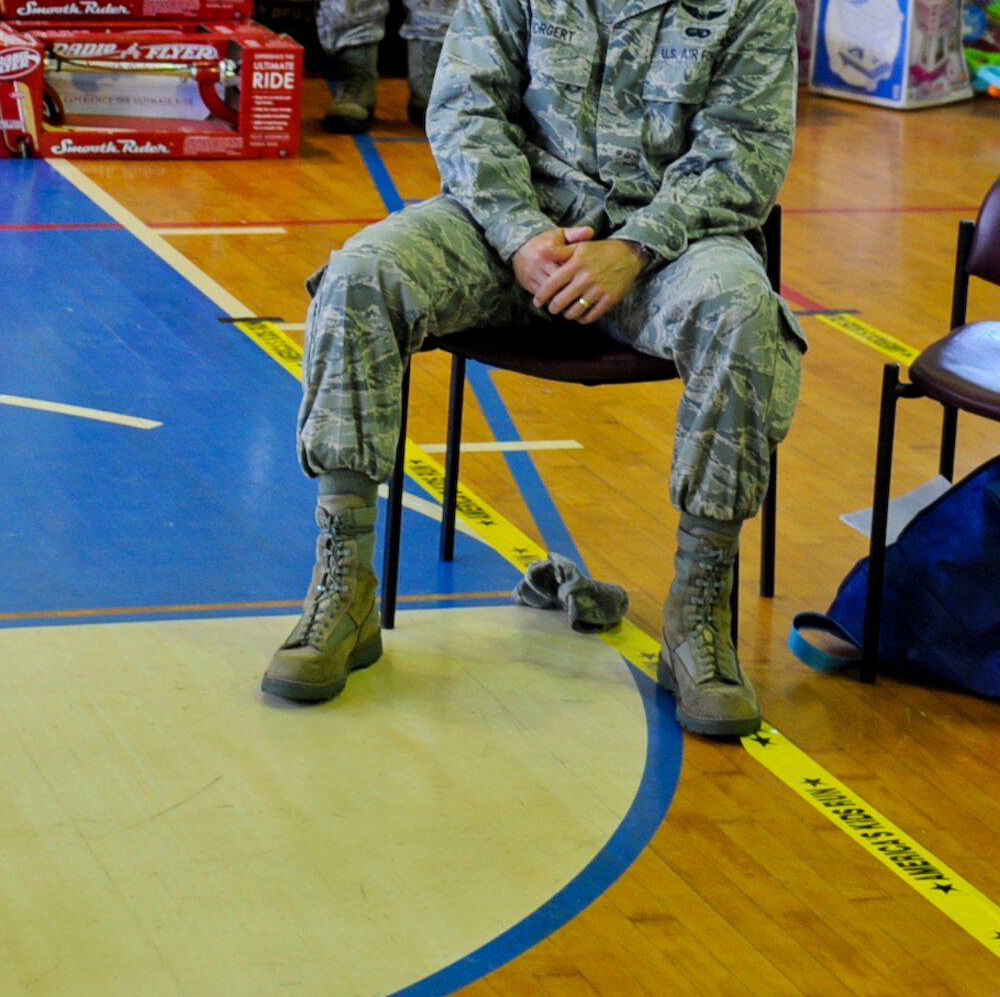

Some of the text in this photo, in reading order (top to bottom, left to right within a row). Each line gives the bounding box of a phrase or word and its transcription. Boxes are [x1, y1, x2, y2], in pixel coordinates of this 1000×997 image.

[17, 0, 130, 15] Smooth Rider
[53, 43, 219, 60] RADIO FLYER
[661, 47, 678, 60] U.S.
[681, 47, 699, 61] AIR
[253, 61, 294, 70] ULTIMATE
[252, 71, 294, 89] RIDE
[51, 139, 171, 155] Smooth Rider
[806, 788, 856, 808] RUN
[831, 808, 885, 830] KIDS
